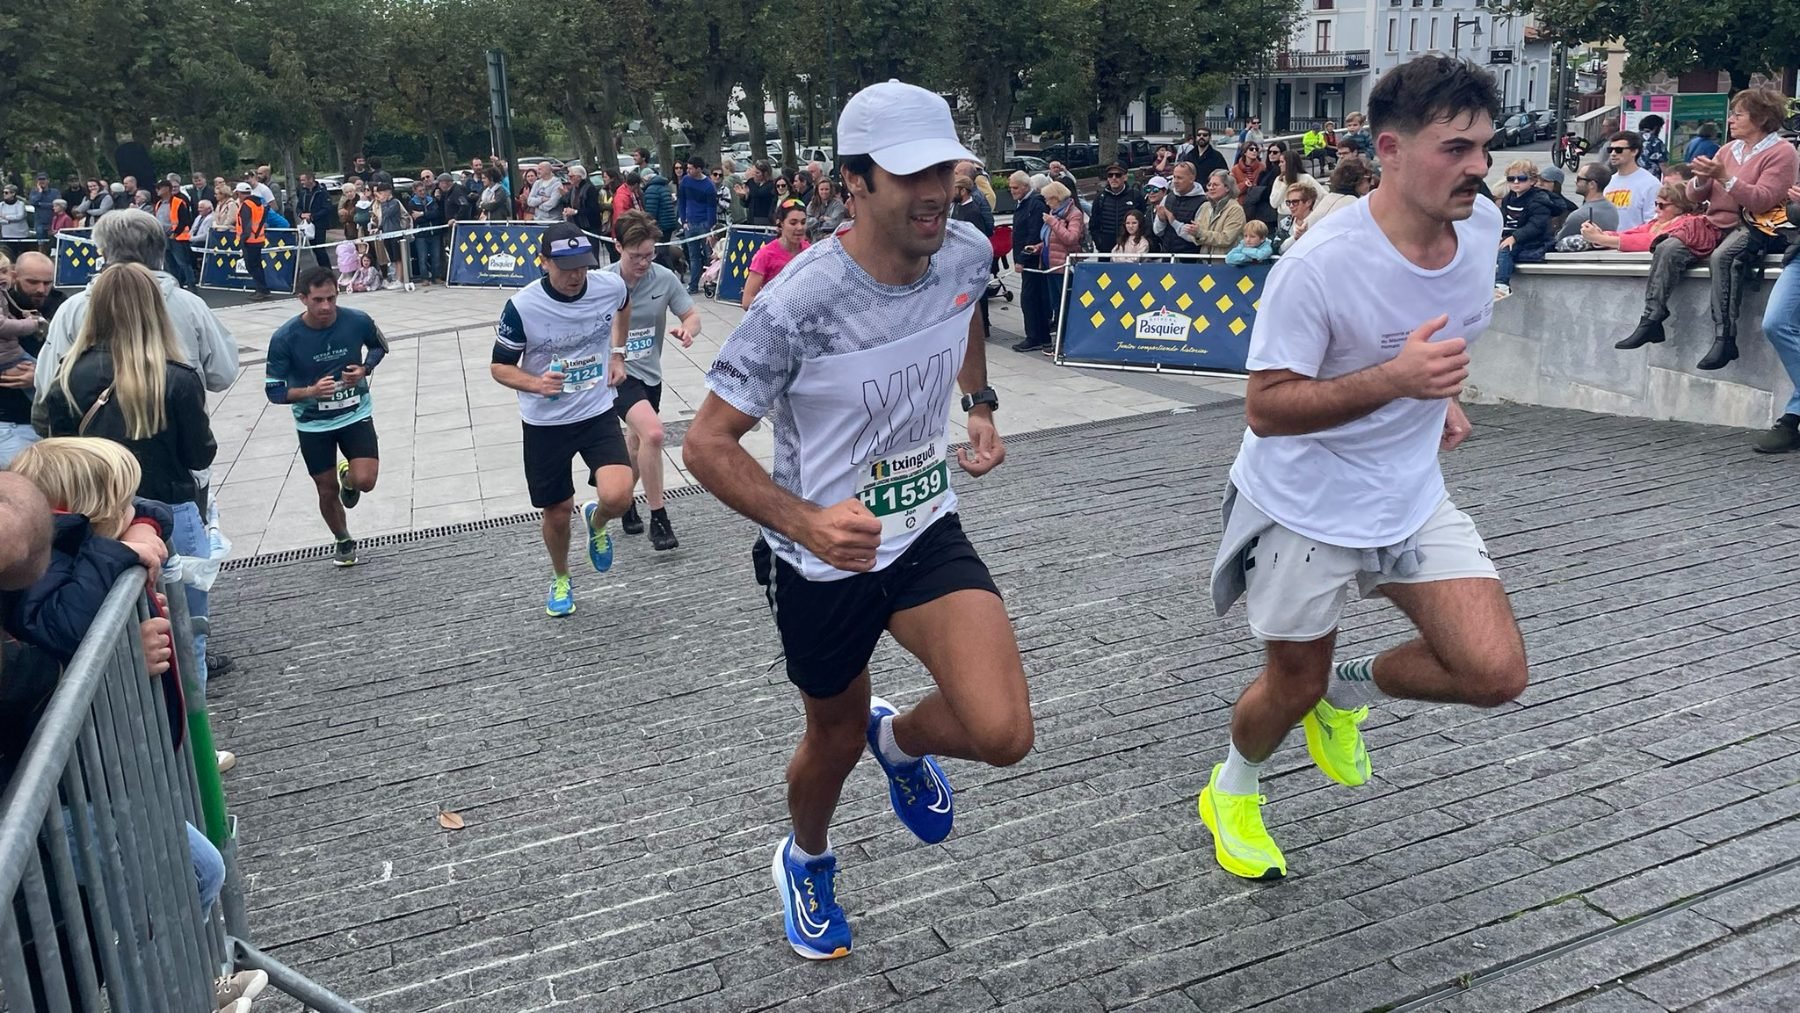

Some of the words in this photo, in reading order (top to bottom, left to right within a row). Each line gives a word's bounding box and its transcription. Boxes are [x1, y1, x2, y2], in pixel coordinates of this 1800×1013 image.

[1139, 319, 1185, 336] Pasquier
[625, 338, 652, 351] 2330
[563, 366, 598, 382] 2124
[892, 442, 935, 472] txingudi
[882, 469, 942, 510] 1539
